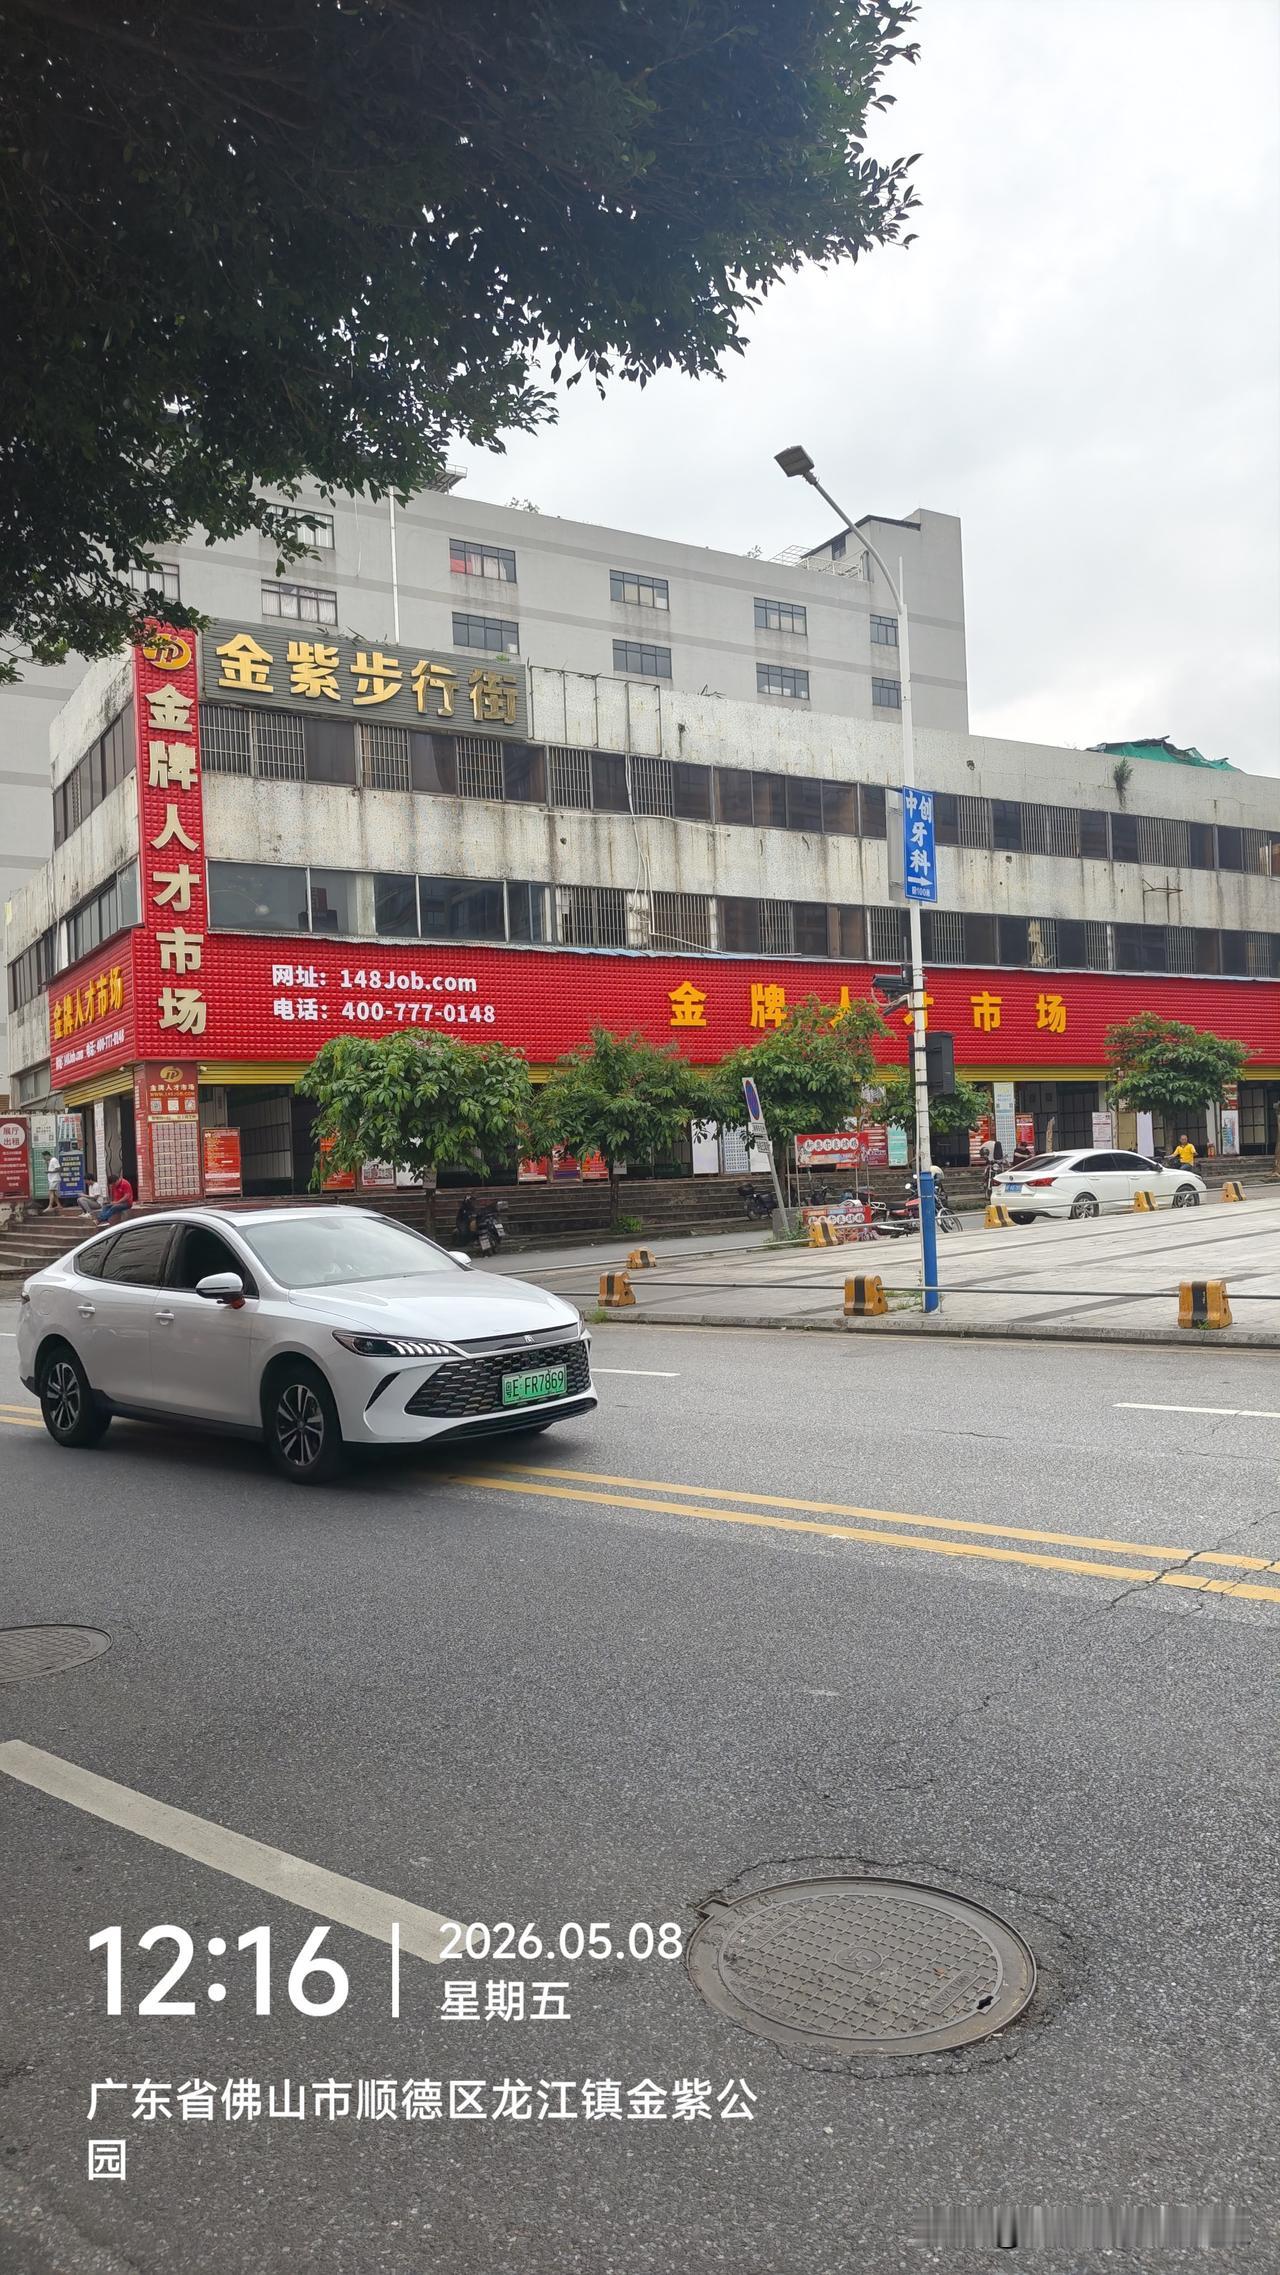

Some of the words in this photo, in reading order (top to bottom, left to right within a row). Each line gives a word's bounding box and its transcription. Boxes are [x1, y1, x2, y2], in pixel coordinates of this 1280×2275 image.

[215, 633, 518, 725] 金紫步行街
[145, 683, 207, 1036] 金牌人才市场
[910, 821, 931, 876] 牙科
[54, 965, 124, 1041] 金牌人才市场
[339, 969, 478, 992] 148Job.com
[341, 1000, 497, 1023] 400-777-0148
